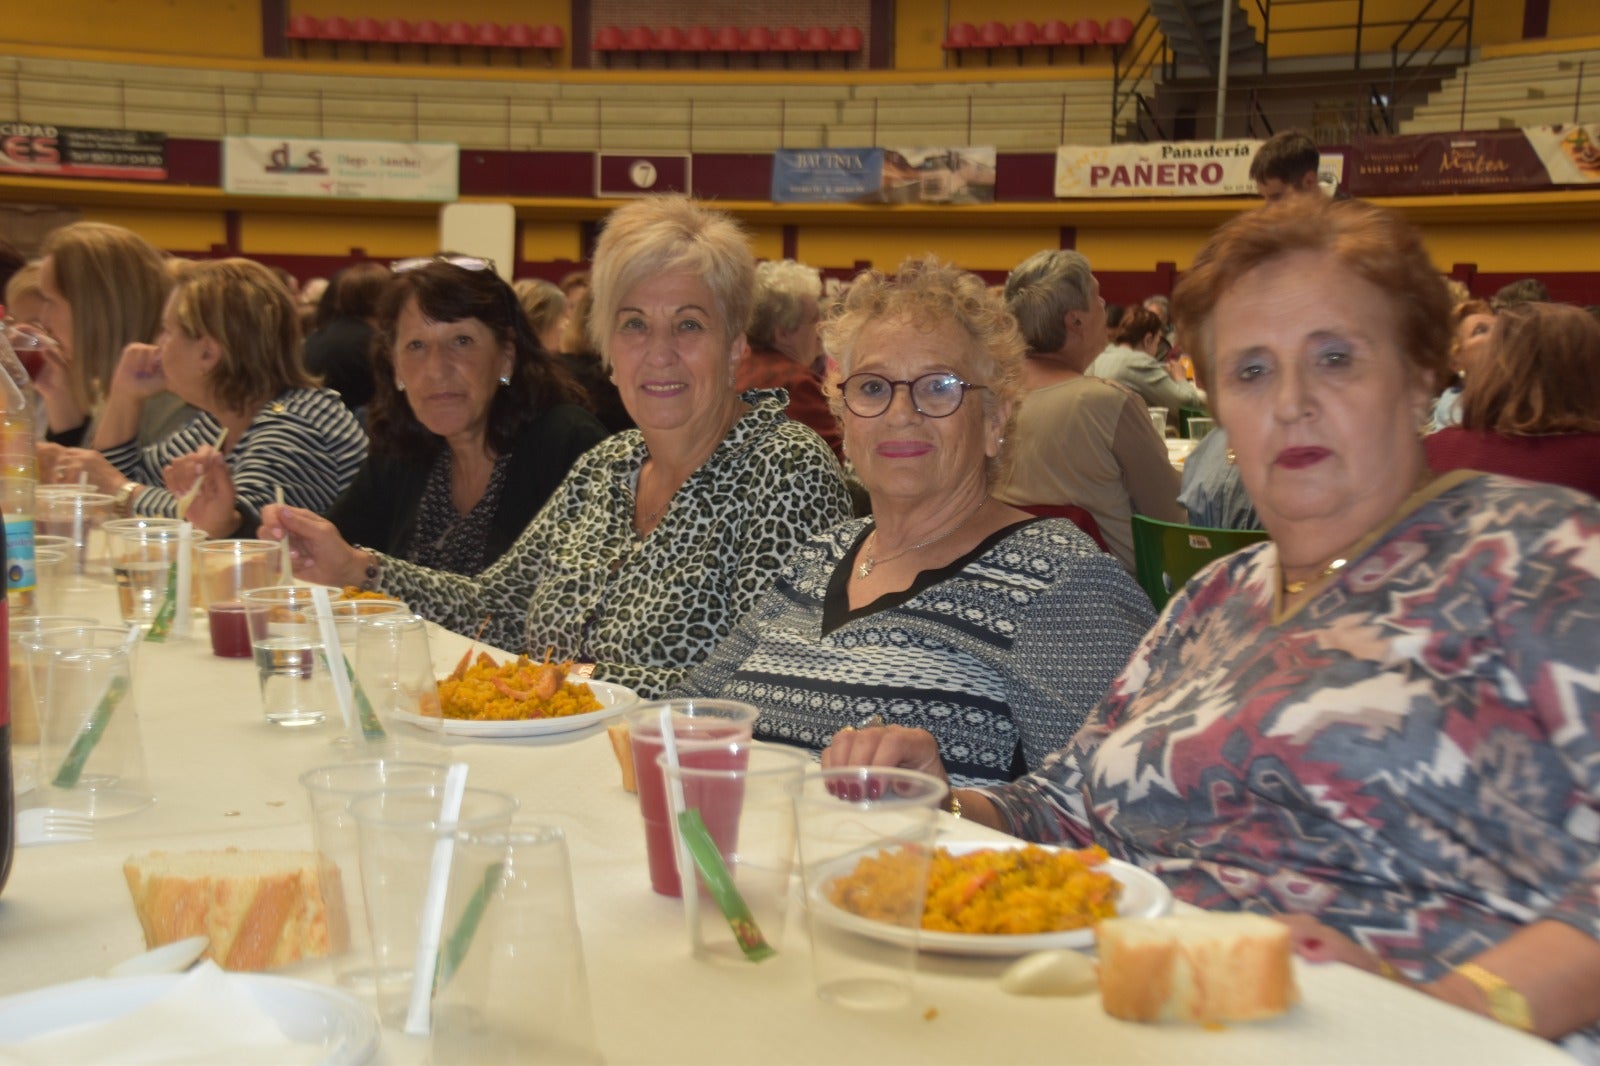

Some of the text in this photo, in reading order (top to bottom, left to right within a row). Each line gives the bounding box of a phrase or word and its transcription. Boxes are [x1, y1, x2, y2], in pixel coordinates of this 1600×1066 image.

[1161, 145, 1249, 159] Panadería
[639, 165, 652, 186] 7
[1089, 157, 1225, 187] PAÑERO
